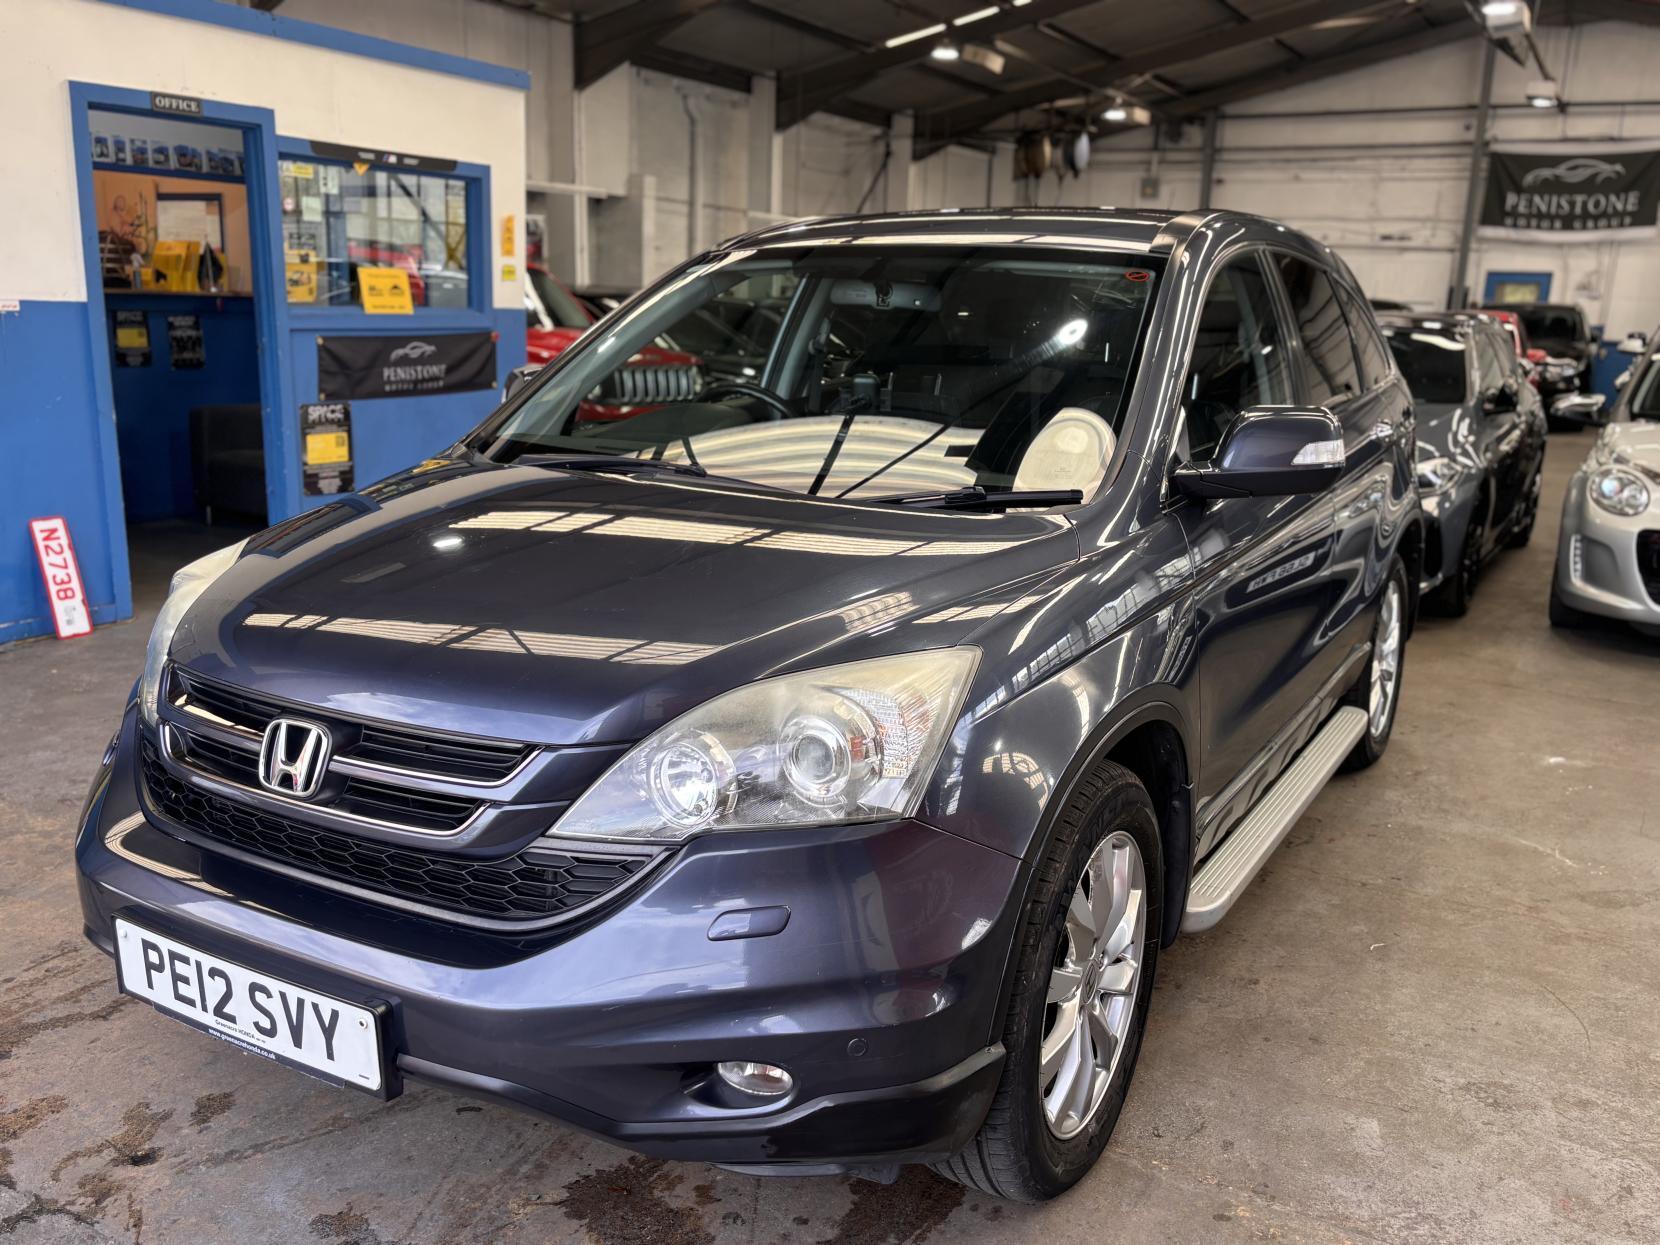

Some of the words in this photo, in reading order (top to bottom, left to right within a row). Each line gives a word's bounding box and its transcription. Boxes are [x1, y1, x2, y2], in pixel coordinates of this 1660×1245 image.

[155, 96, 199, 112] OFFICE
[1504, 191, 1640, 215] PENISTONE
[141, 938, 237, 1025] PE12
[248, 981, 340, 1062] SVY
